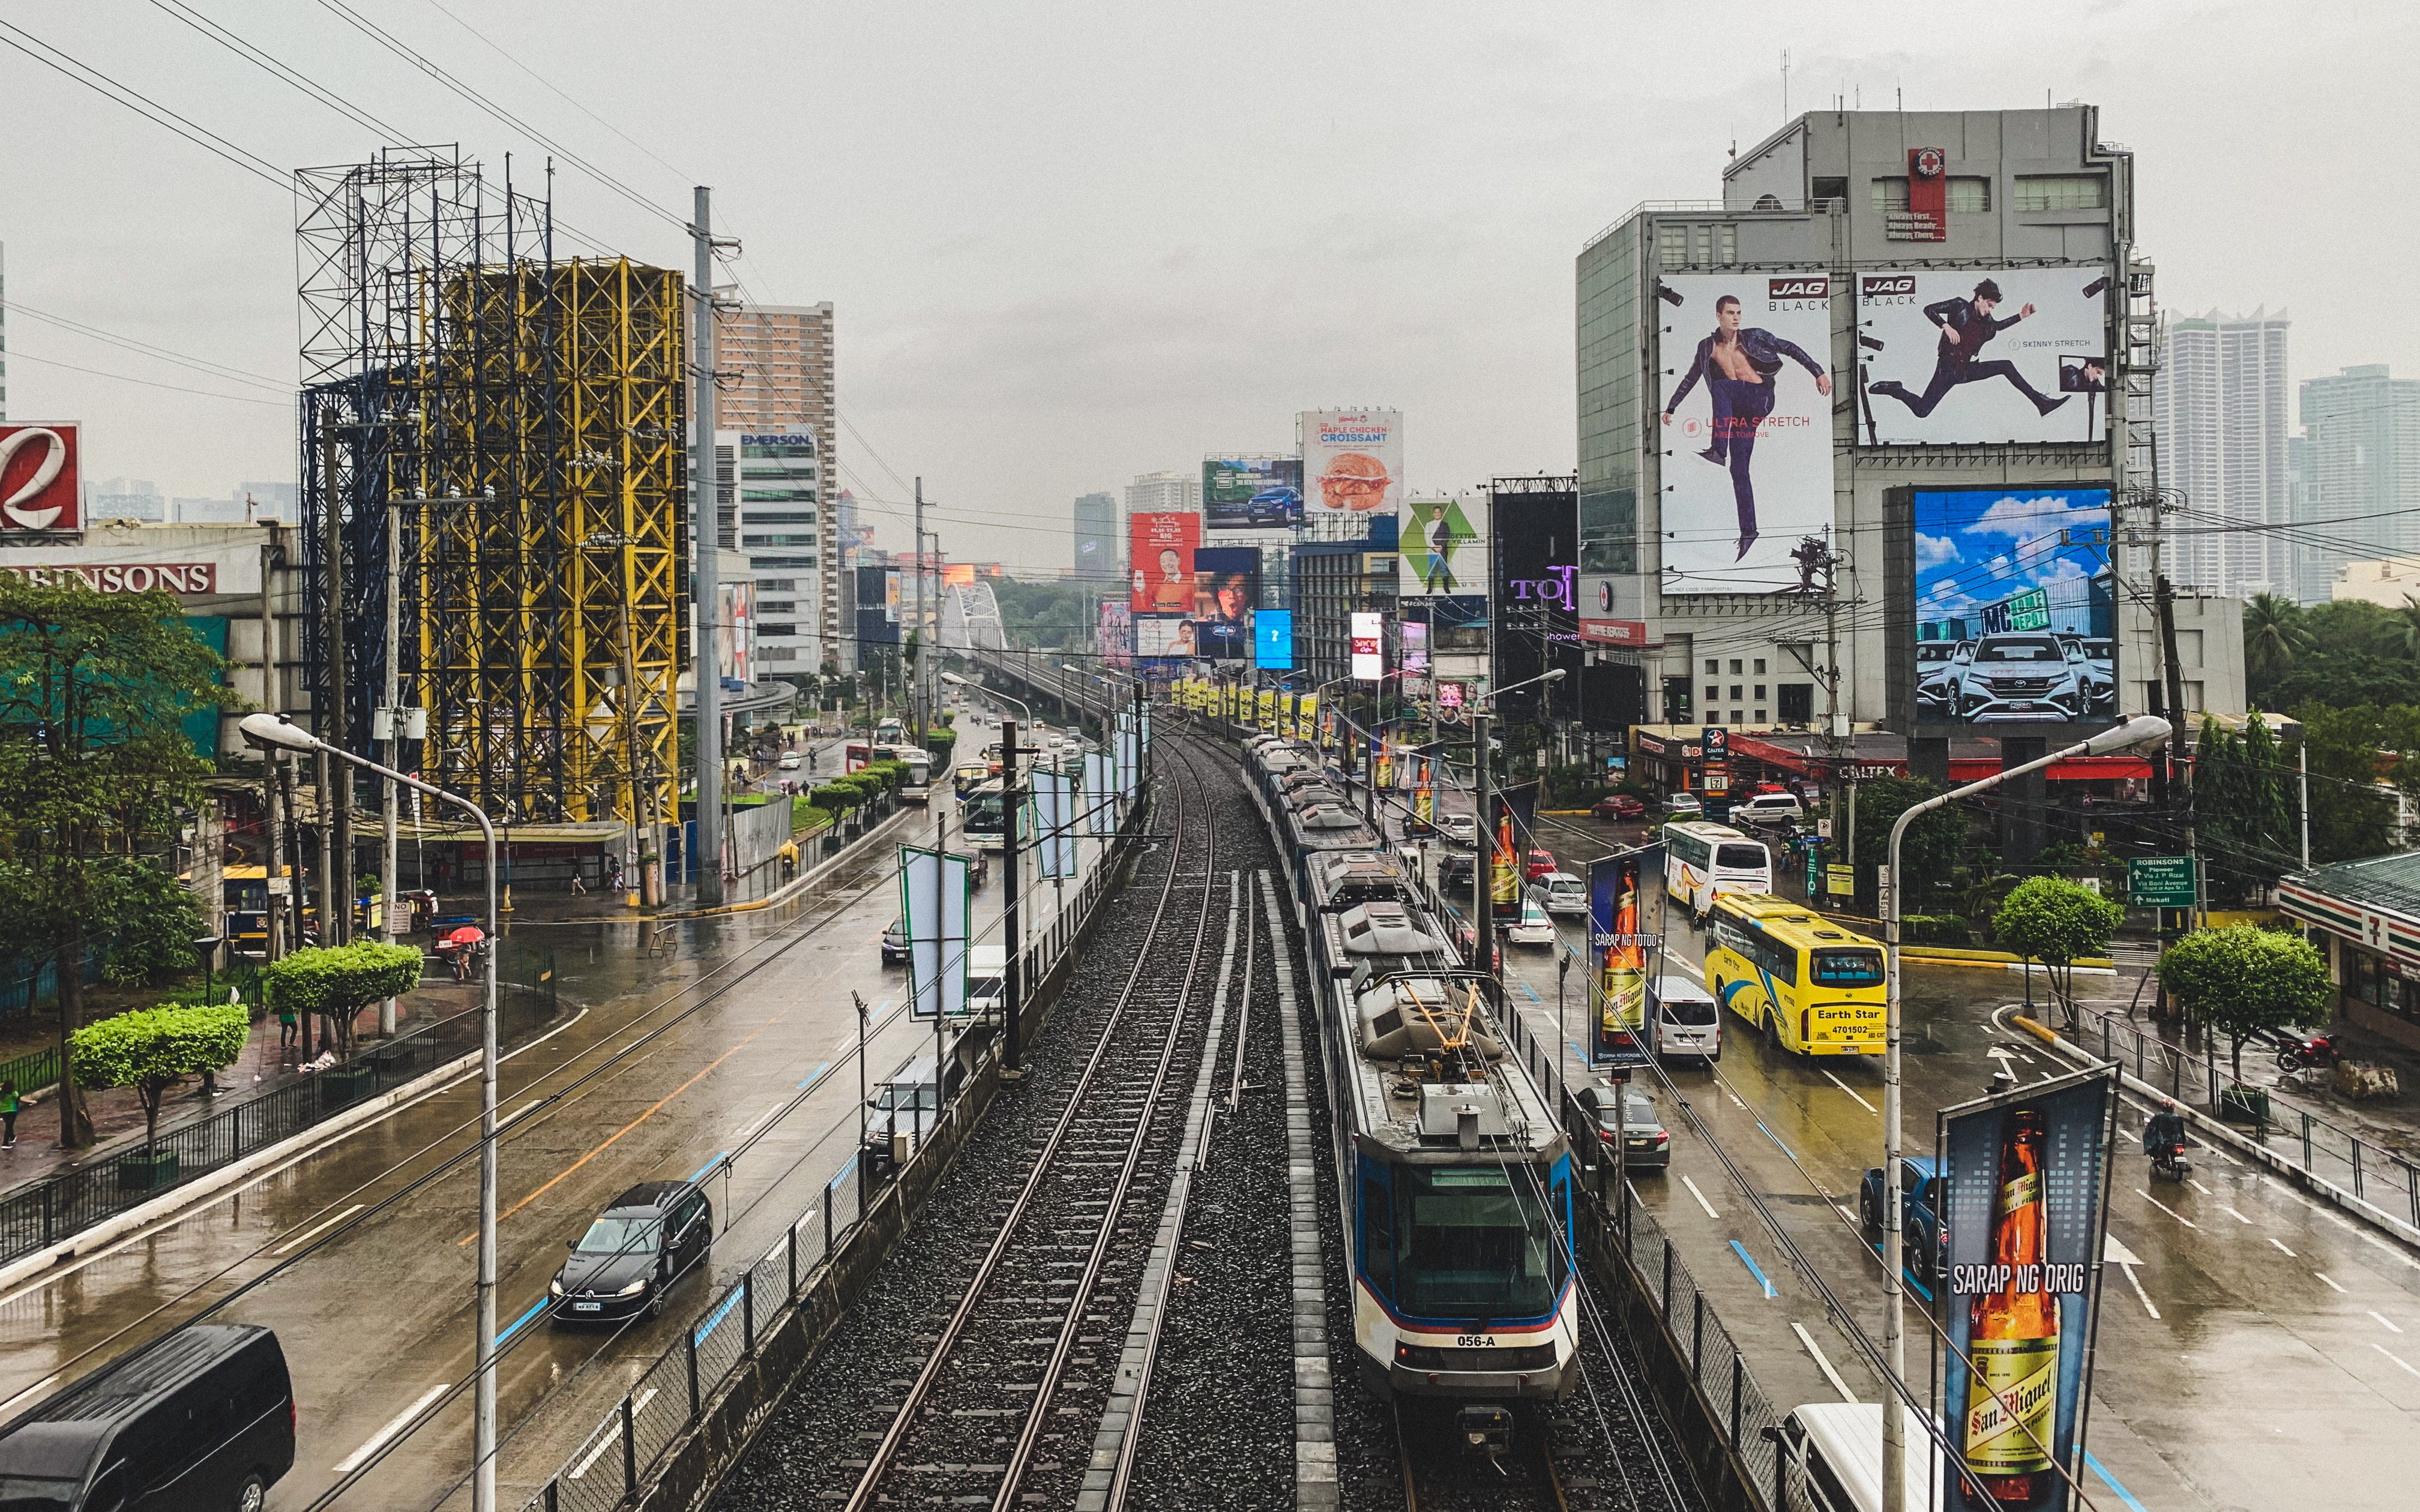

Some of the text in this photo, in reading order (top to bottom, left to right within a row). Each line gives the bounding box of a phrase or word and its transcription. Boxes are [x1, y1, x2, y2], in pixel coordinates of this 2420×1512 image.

[1928, 164, 1943, 175] CROSS
[1888, 212, 1913, 220] Always
[1772, 283, 1825, 295] JAG
[1865, 280, 1913, 292] JAG
[1769, 301, 1829, 311] BLACK
[1862, 296, 1916, 305] BLACK
[1706, 416, 1810, 428] ULTRA STRETCH
[741, 434, 813, 445] EMERSON
[1983, 603, 2012, 634] MC
[1595, 933, 1657, 946] SARAP NG TOTOO
[1855, 1010, 1880, 1018] Star
[1953, 1263, 2084, 1294] SARAP NG ORIG
[1457, 1336, 1495, 1346] 056-A
[1971, 1367, 2051, 1437] San Miguel
